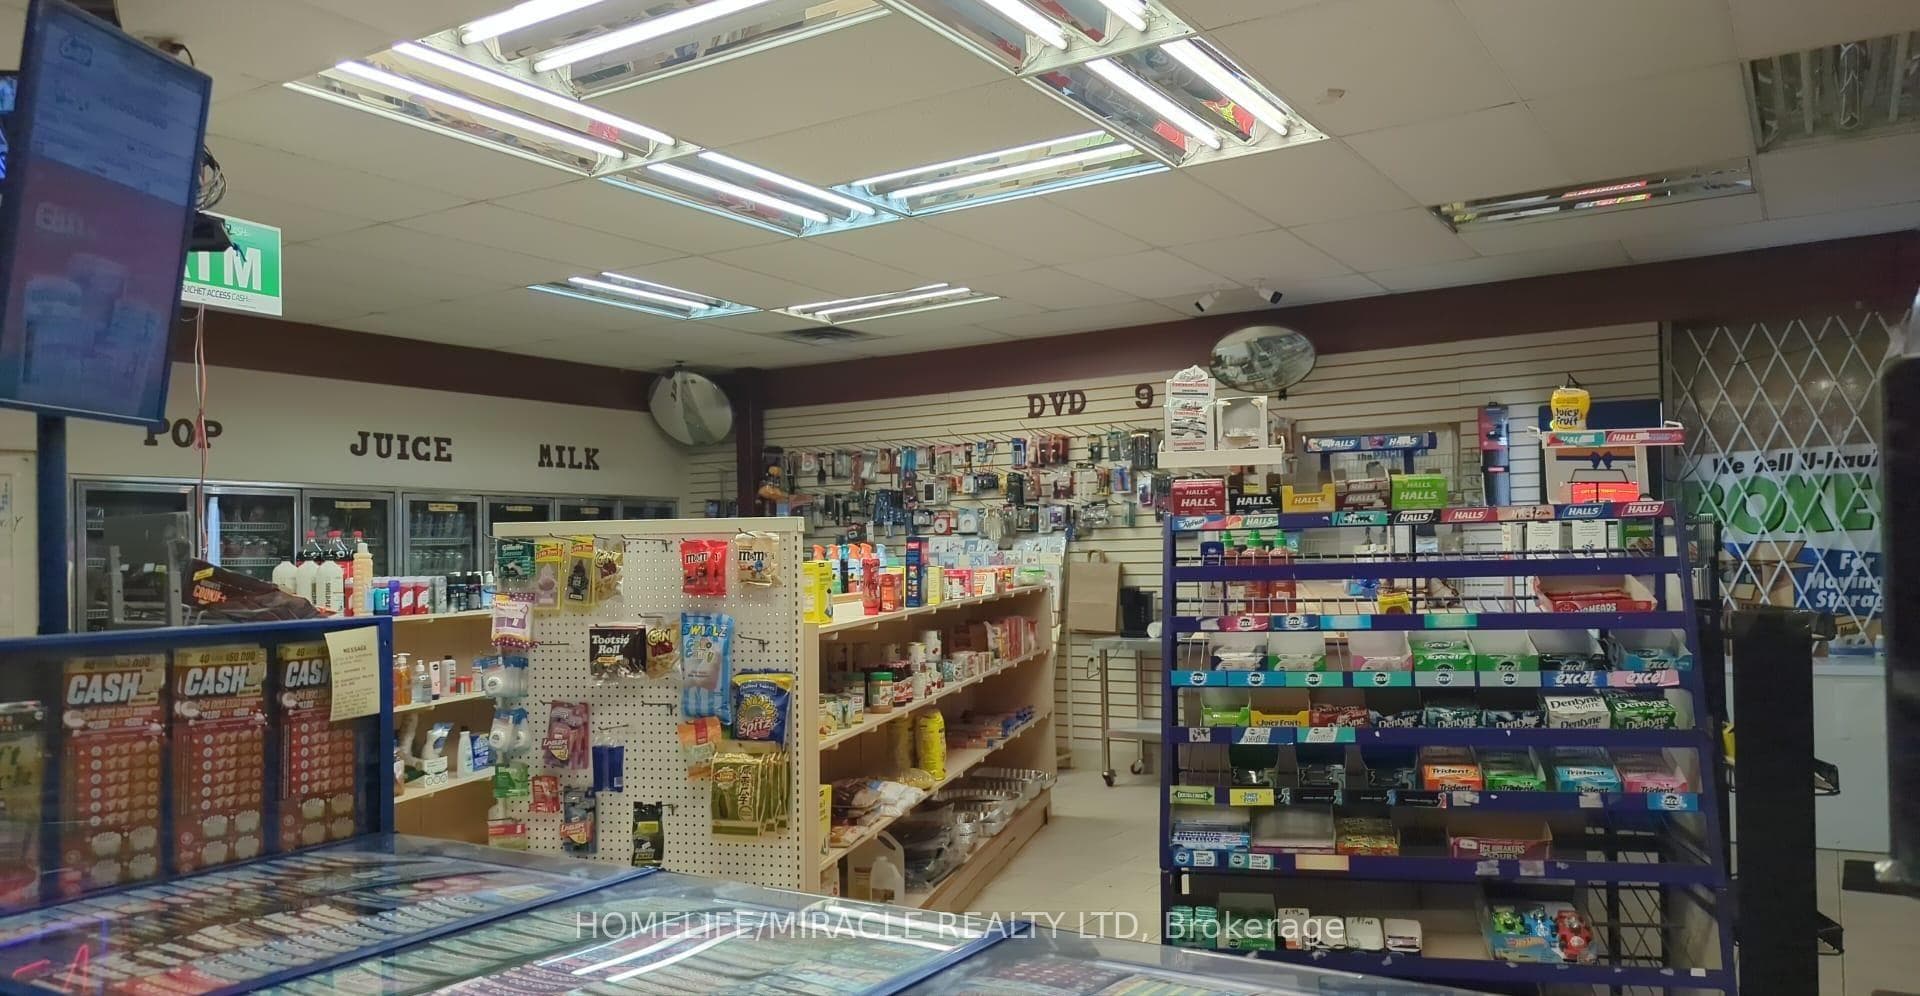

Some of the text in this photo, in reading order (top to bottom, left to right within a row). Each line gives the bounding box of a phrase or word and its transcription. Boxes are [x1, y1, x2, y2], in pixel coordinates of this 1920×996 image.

[207, 288, 231, 300] ACCESS
[1027, 384, 1153, 418] DVD 9
[144, 418, 223, 448] POP
[350, 430, 453, 462] JUICE
[538, 444, 600, 471] MILK
[1754, 453, 1793, 474] Sell
[1236, 496, 1273, 506] HALLS
[1294, 496, 1323, 504] HALLS
[1400, 490, 1438, 500] HALLS
[1181, 497, 1217, 507] HALLS
[1454, 511, 1484, 520] HALLS
[1568, 506, 1600, 516] HALLS
[1627, 505, 1660, 514] HALLS
[1246, 517, 1274, 526] HALLS
[1400, 513, 1429, 522] HALLS
[1840, 552, 1875, 572] For
[598, 644, 621, 654] Roll
[184, 664, 248, 696] CASH
[1556, 670, 1595, 685] excel
[1626, 669, 1666, 685] excel
[67, 672, 140, 705] CASH
[1550, 696, 1601, 709] Dentyne
[740, 717, 772, 737] Spitz
[1261, 719, 1298, 727] Juicy Fruit
[1378, 714, 1417, 728] Dentyne
[1437, 714, 1478, 728] Dentyne
[1560, 716, 1601, 728] Dentyne
[1626, 715, 1670, 729] Dentyne
[1440, 783, 1472, 791] Trident
